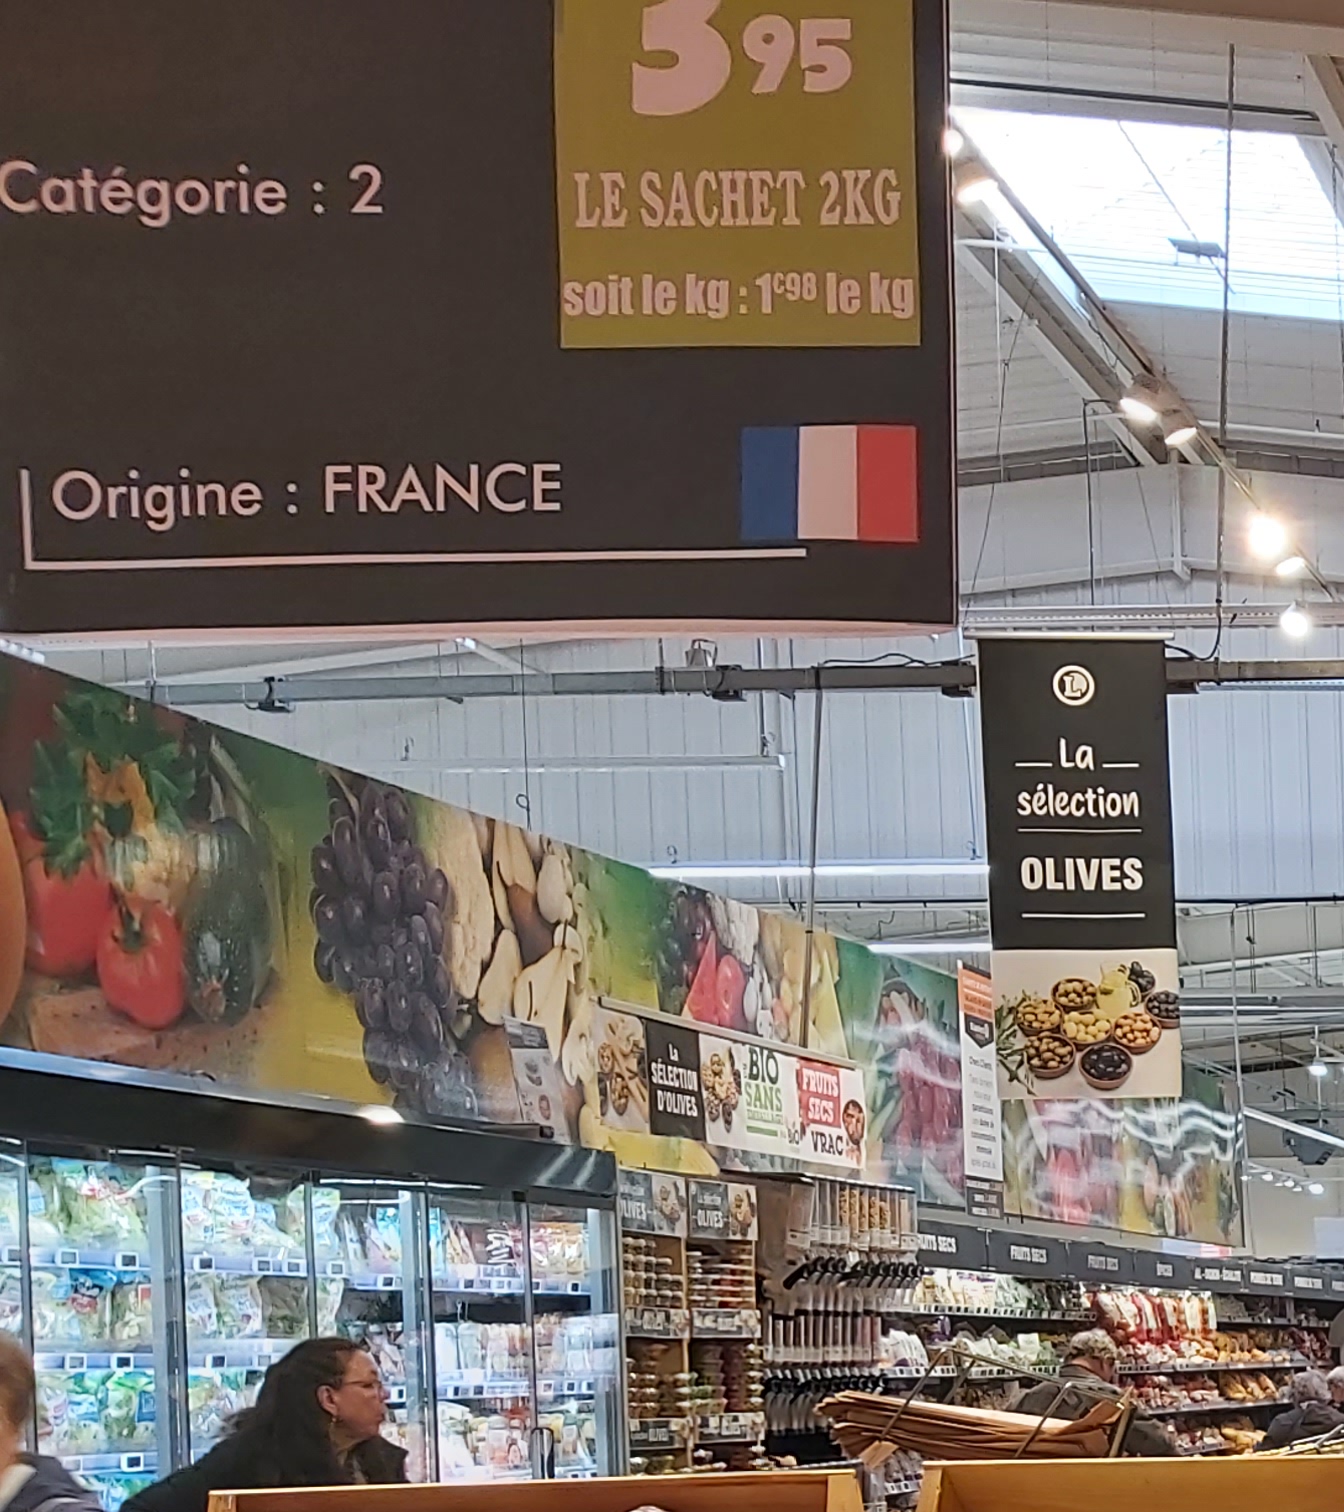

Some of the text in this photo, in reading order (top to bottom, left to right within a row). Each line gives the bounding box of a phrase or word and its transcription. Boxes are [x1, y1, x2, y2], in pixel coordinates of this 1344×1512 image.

[741, 13, 853, 96] 95
[2, 161, 288, 230] Catégorie
[348, 163, 385, 215] 2
[573, 167, 902, 229] LE SACHET 2KG
[562, 273, 635, 317] soit
[641, 273, 678, 317] le
[684, 272, 731, 320] kg
[825, 271, 862, 316] le
[869, 271, 916, 321] kg
[50, 467, 264, 535] Origine
[322, 460, 563, 516] FRANCE
[1058, 737, 1096, 771] La
[1016, 782, 1141, 821] sélection
[1020, 855, 1144, 892] OLIVES
[651, 1058, 699, 1092] SÉLECTION
[748, 1047, 779, 1085] BIO
[802, 1067, 839, 1098] FRUITS
[656, 1089, 698, 1117] D'OLIVES
[744, 1081, 783, 1113] SANS
[808, 1096, 835, 1123] SECS
[811, 1130, 844, 1156] VRAC
[919, 1233, 957, 1254] UITS SECS
